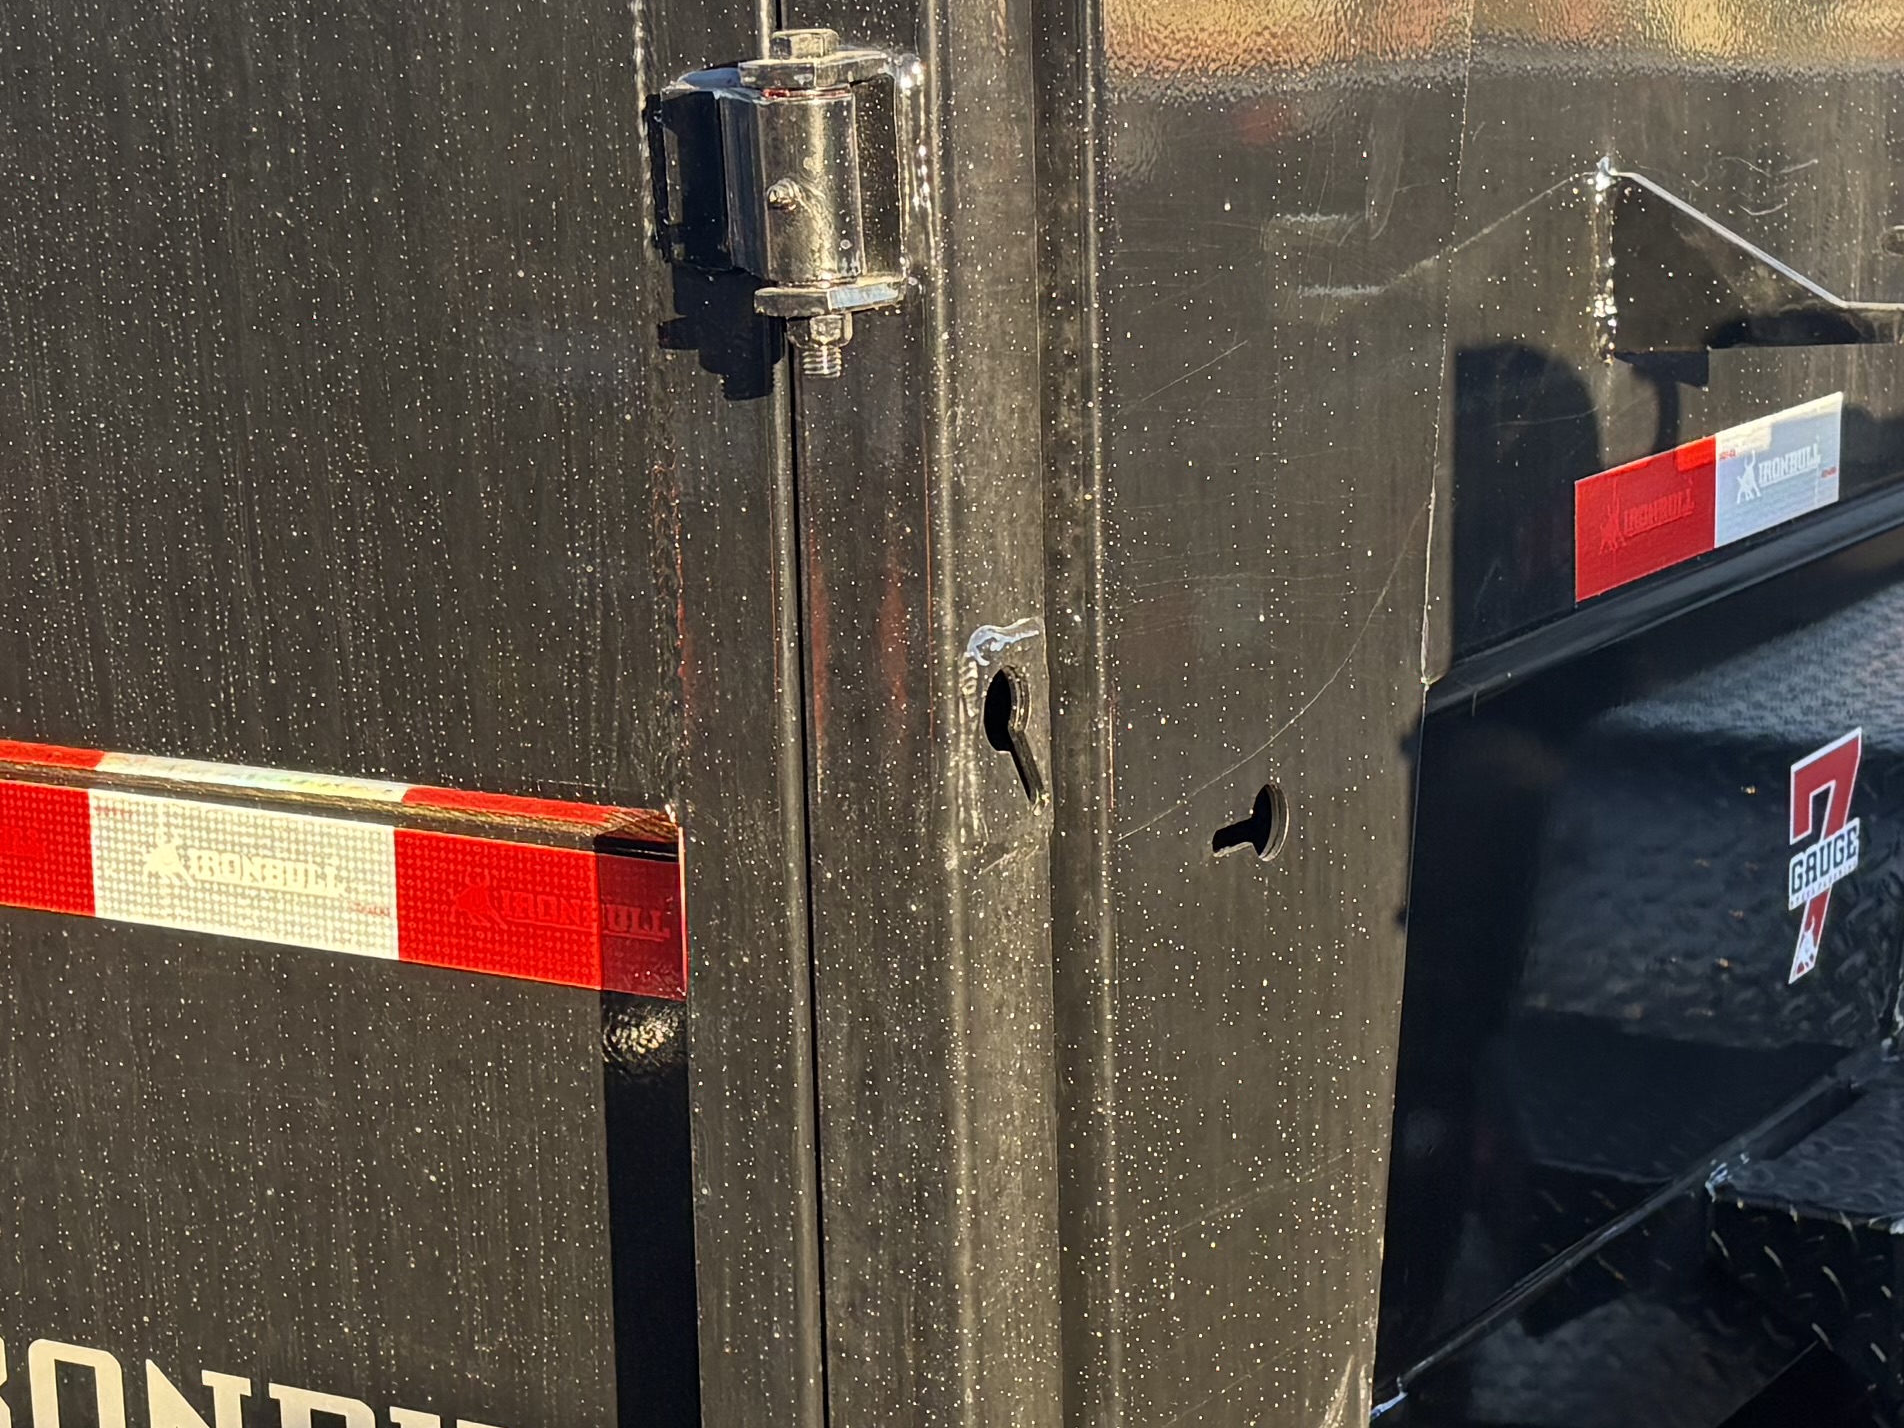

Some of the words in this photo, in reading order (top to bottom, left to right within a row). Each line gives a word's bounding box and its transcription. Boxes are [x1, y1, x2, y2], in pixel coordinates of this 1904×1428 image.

[1758, 443, 1821, 486] IRONBULL
[187, 847, 346, 896] IRONBULL
[1792, 824, 1858, 895] GAUGE
[500, 889, 670, 939] IRONULL
